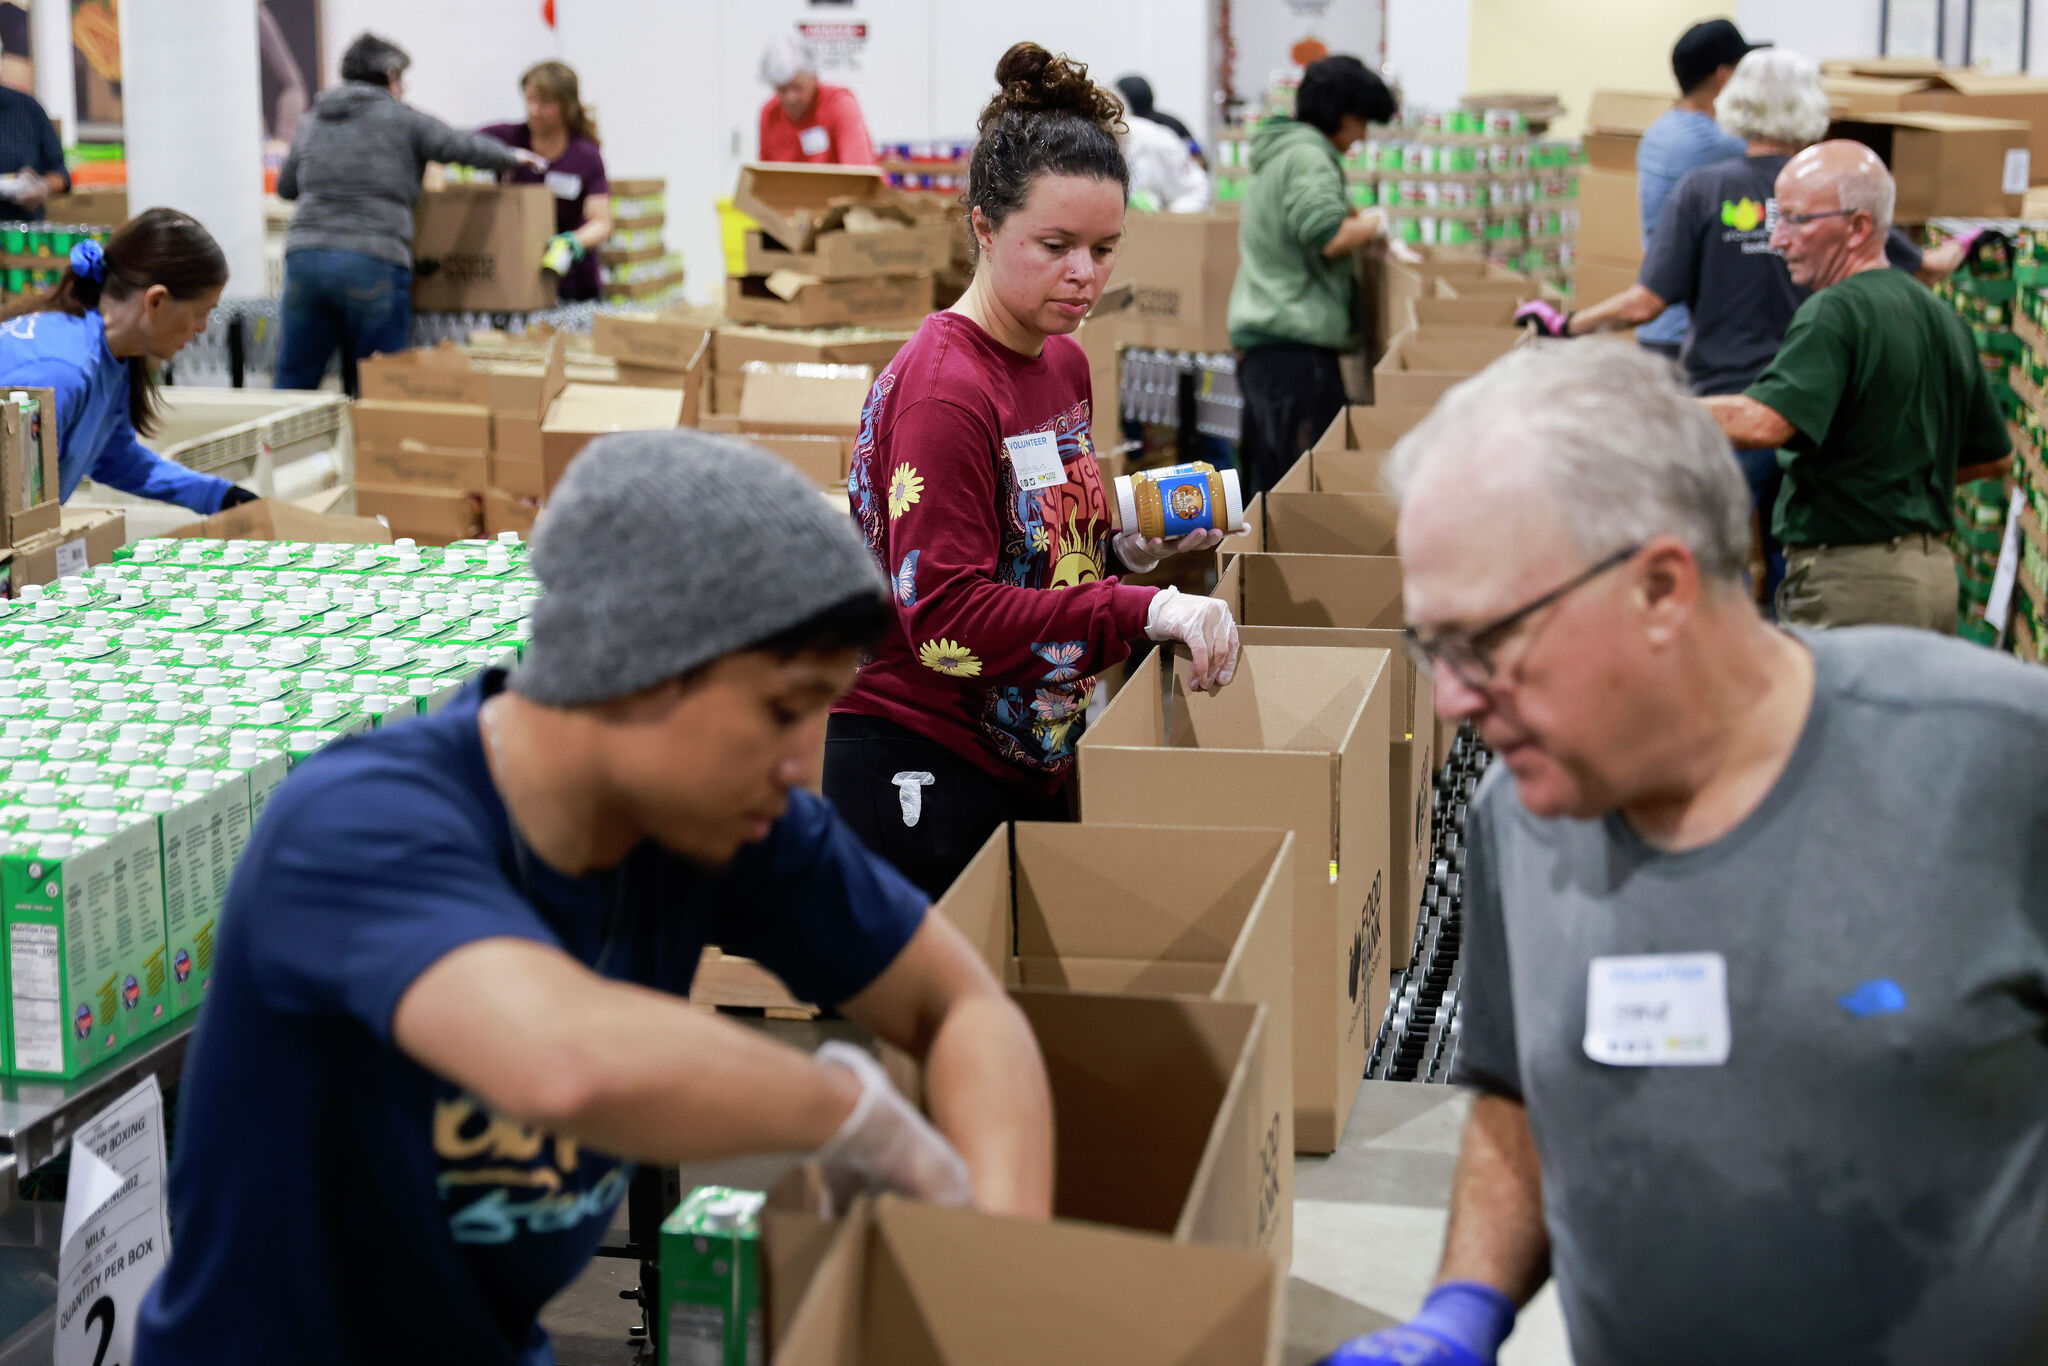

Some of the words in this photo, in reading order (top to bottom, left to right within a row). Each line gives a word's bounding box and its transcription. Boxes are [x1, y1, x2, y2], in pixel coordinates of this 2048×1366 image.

[1009, 436, 1048, 450] VOLUNTEER
[1361, 868, 1382, 943] FOOD
[109, 1116, 146, 1152] BOXING
[85, 1225, 107, 1251] MILK
[60, 1273, 101, 1331] QUANTITY
[104, 1257, 125, 1283] PER
[128, 1237, 154, 1267] BOX
[84, 1294, 120, 1366] 2
